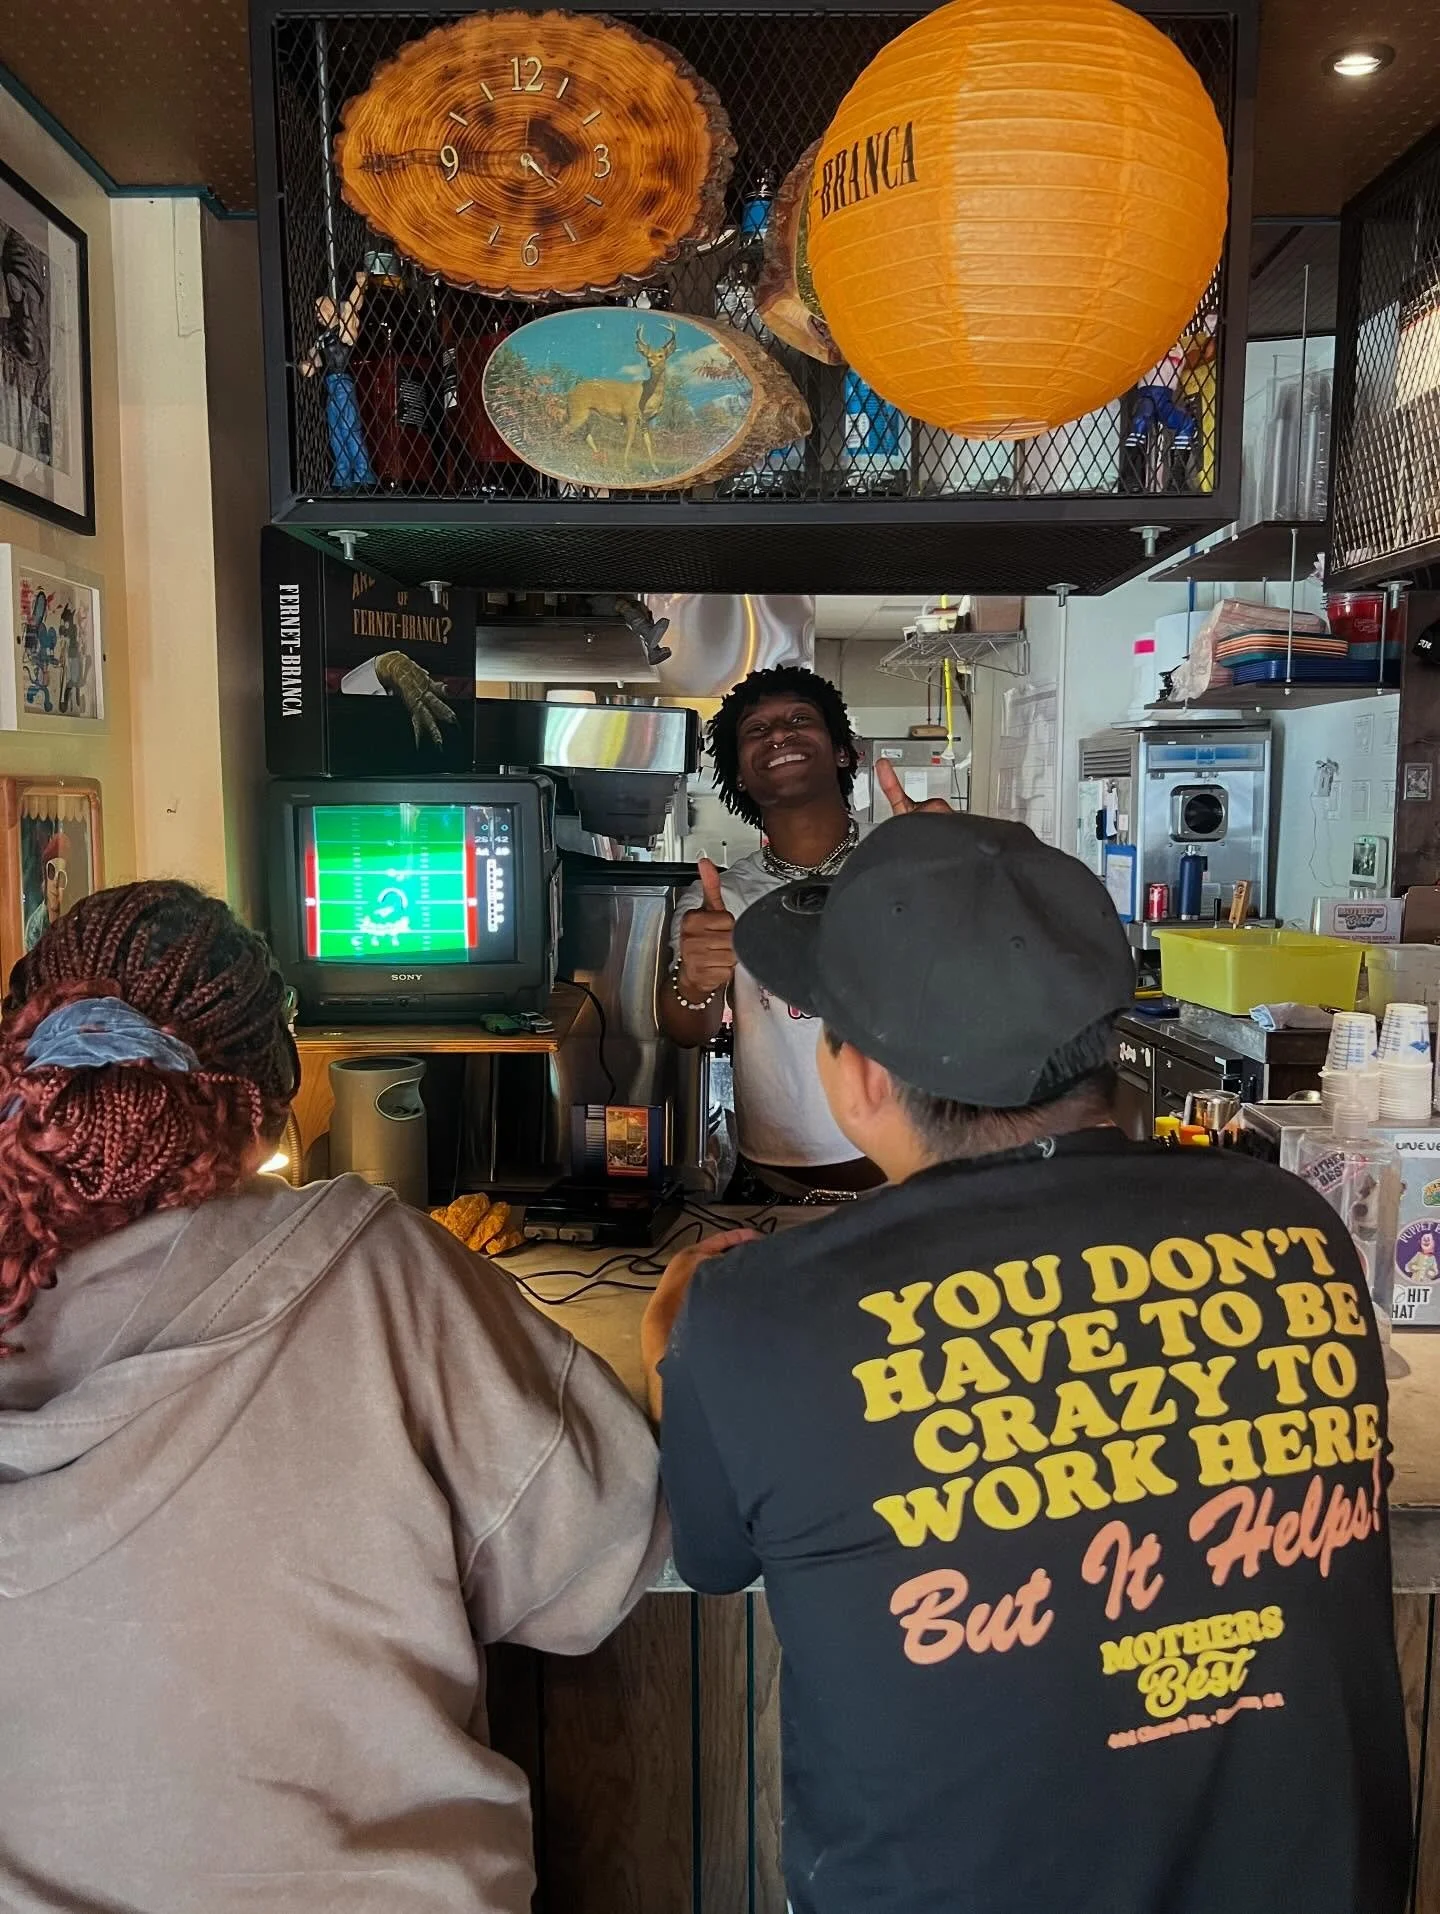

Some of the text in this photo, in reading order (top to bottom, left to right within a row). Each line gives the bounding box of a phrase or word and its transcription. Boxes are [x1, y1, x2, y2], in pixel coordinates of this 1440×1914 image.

[510, 56, 544, 92] 12
[440, 145, 459, 182] 9
[593, 143, 611, 179] 3
[521, 232, 540, 267] 6
[279, 583, 303, 717] FERNET-BRANCA
[352, 608, 453, 645] FERNET-BRANCA?
[858, 1226, 1336, 1347] YOU DON'T
[1408, 1287, 1430, 1303] HIT
[852, 1281, 1369, 1422] HAVE TO BE
[913, 1341, 1358, 1474] CRAZY TO
[873, 1404, 1382, 1548] WORK HERE
[889, 1449, 1382, 1666] But It Helps!
[1100, 1605, 1285, 1675] MOTHERS
[1137, 1647, 1257, 1719] Best
